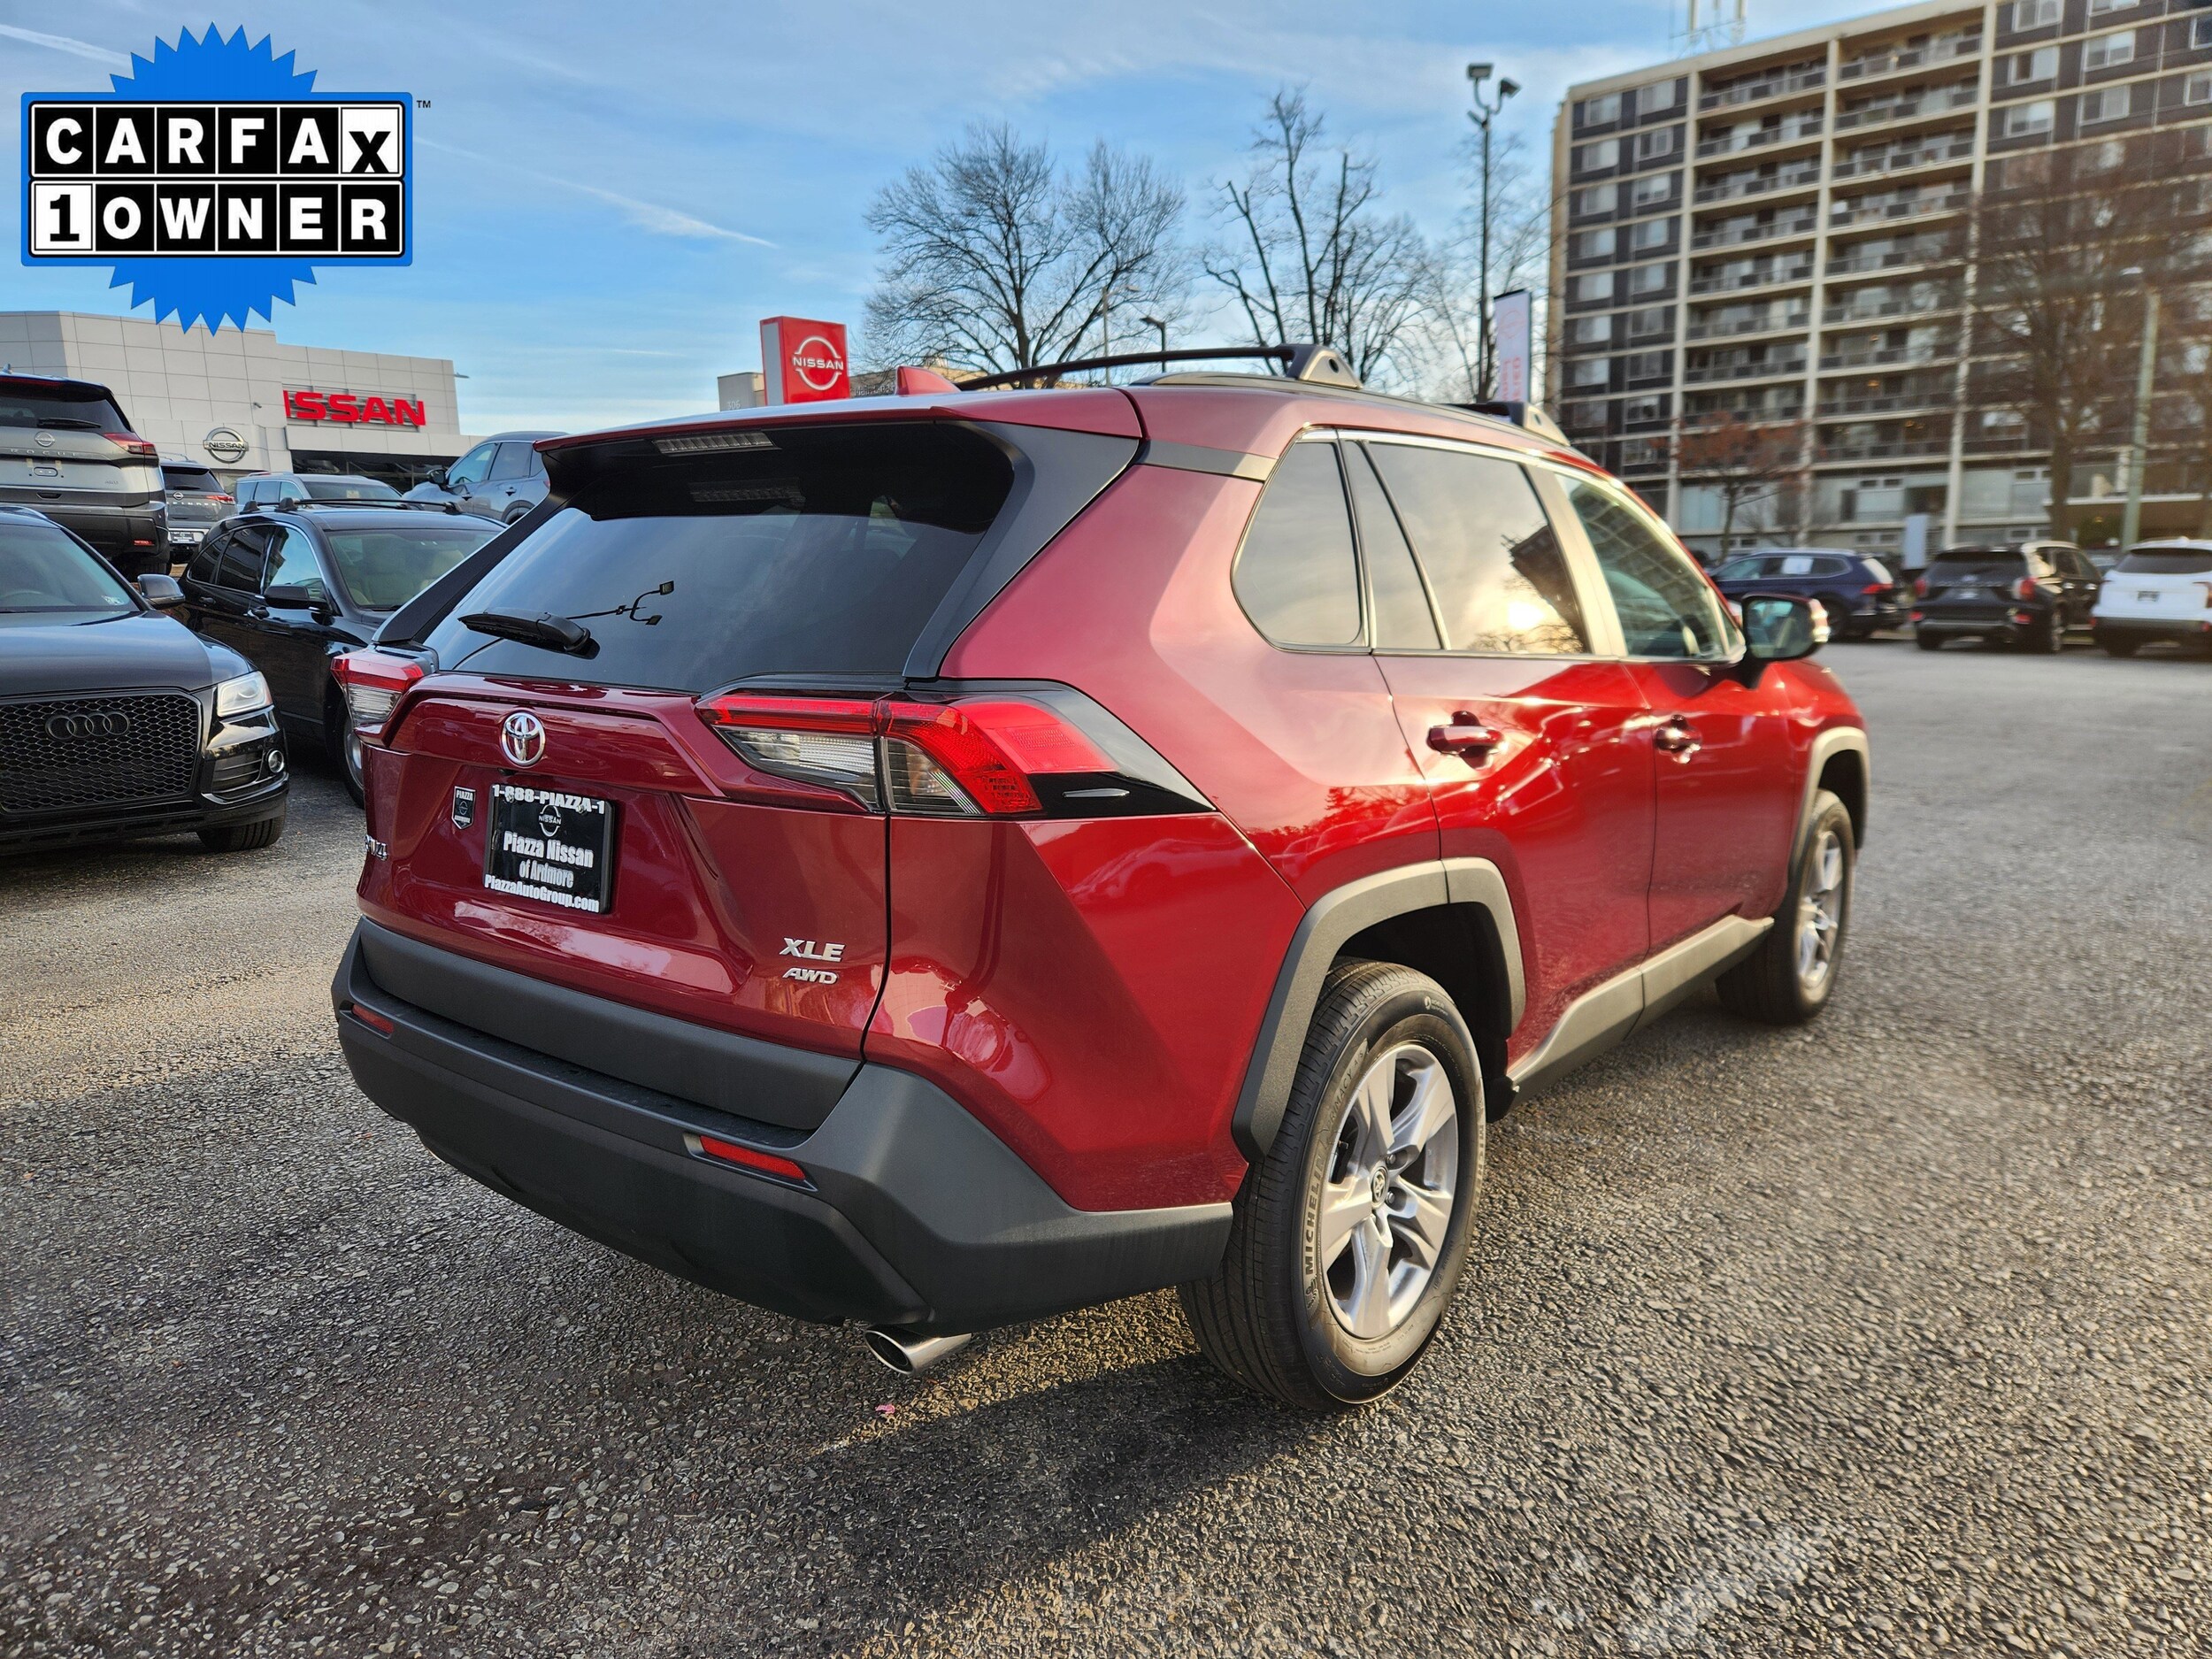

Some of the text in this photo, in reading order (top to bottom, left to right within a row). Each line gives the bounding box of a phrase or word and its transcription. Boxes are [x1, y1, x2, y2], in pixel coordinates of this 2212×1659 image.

[793, 356, 844, 371] NISSAN
[208, 441, 247, 451] NISSAN
[456, 789, 473, 802] PIAZZA
[492, 784, 605, 814] 1-888-PIAZZA-1
[538, 814, 562, 825] NISSAN
[503, 831, 595, 868] Piazza Nissan
[518, 859, 574, 888] of Ardmore
[484, 873, 600, 913] PiazzaAutoGroup.com
[779, 937, 846, 963] XLE
[781, 967, 839, 985] AWD
[1304, 1152, 1327, 1276] MICHELIN
